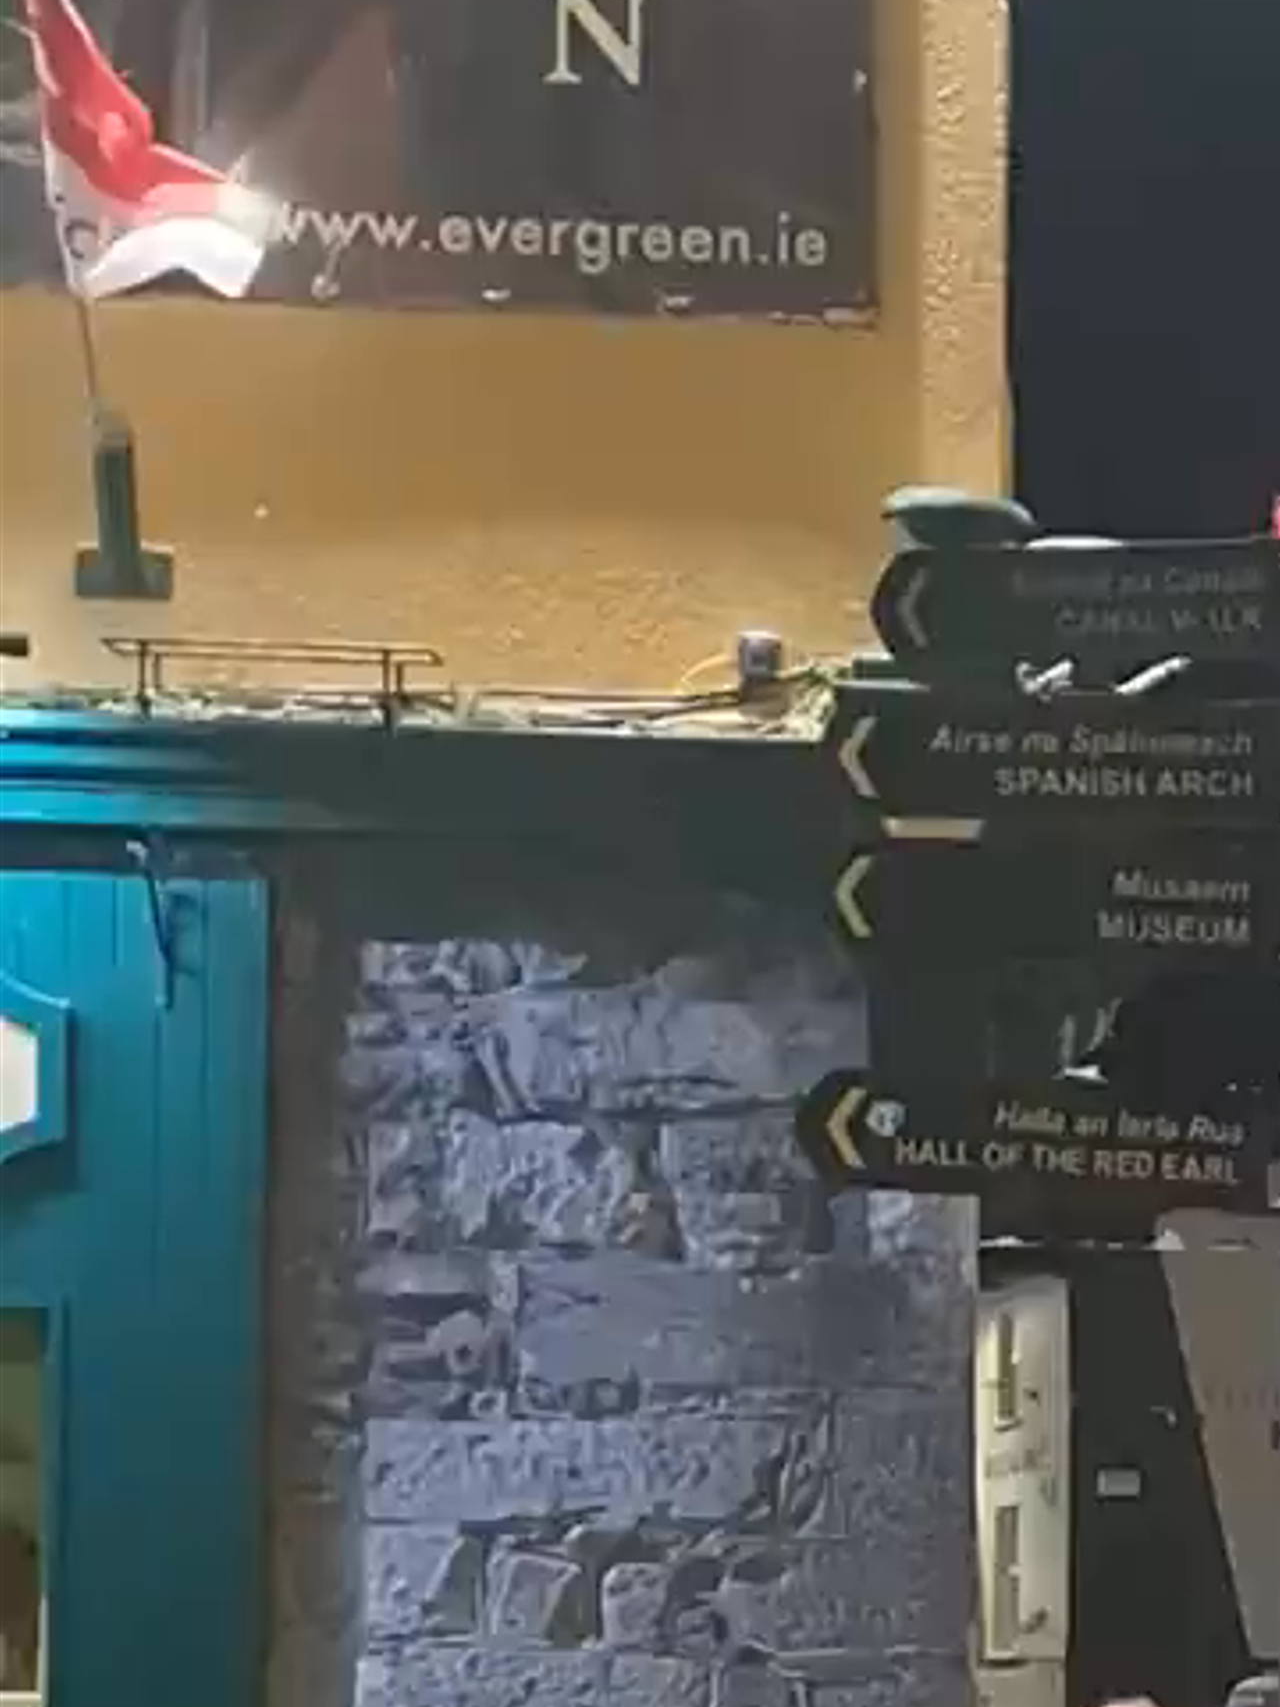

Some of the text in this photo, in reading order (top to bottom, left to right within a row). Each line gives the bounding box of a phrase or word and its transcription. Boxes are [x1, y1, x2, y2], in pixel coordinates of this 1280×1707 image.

[994, 766, 1253, 797] SPANISH ARCH
[1097, 910, 1252, 944] MUSEUM
[894, 1137, 1241, 1186] HALL OF THE RED EARL
